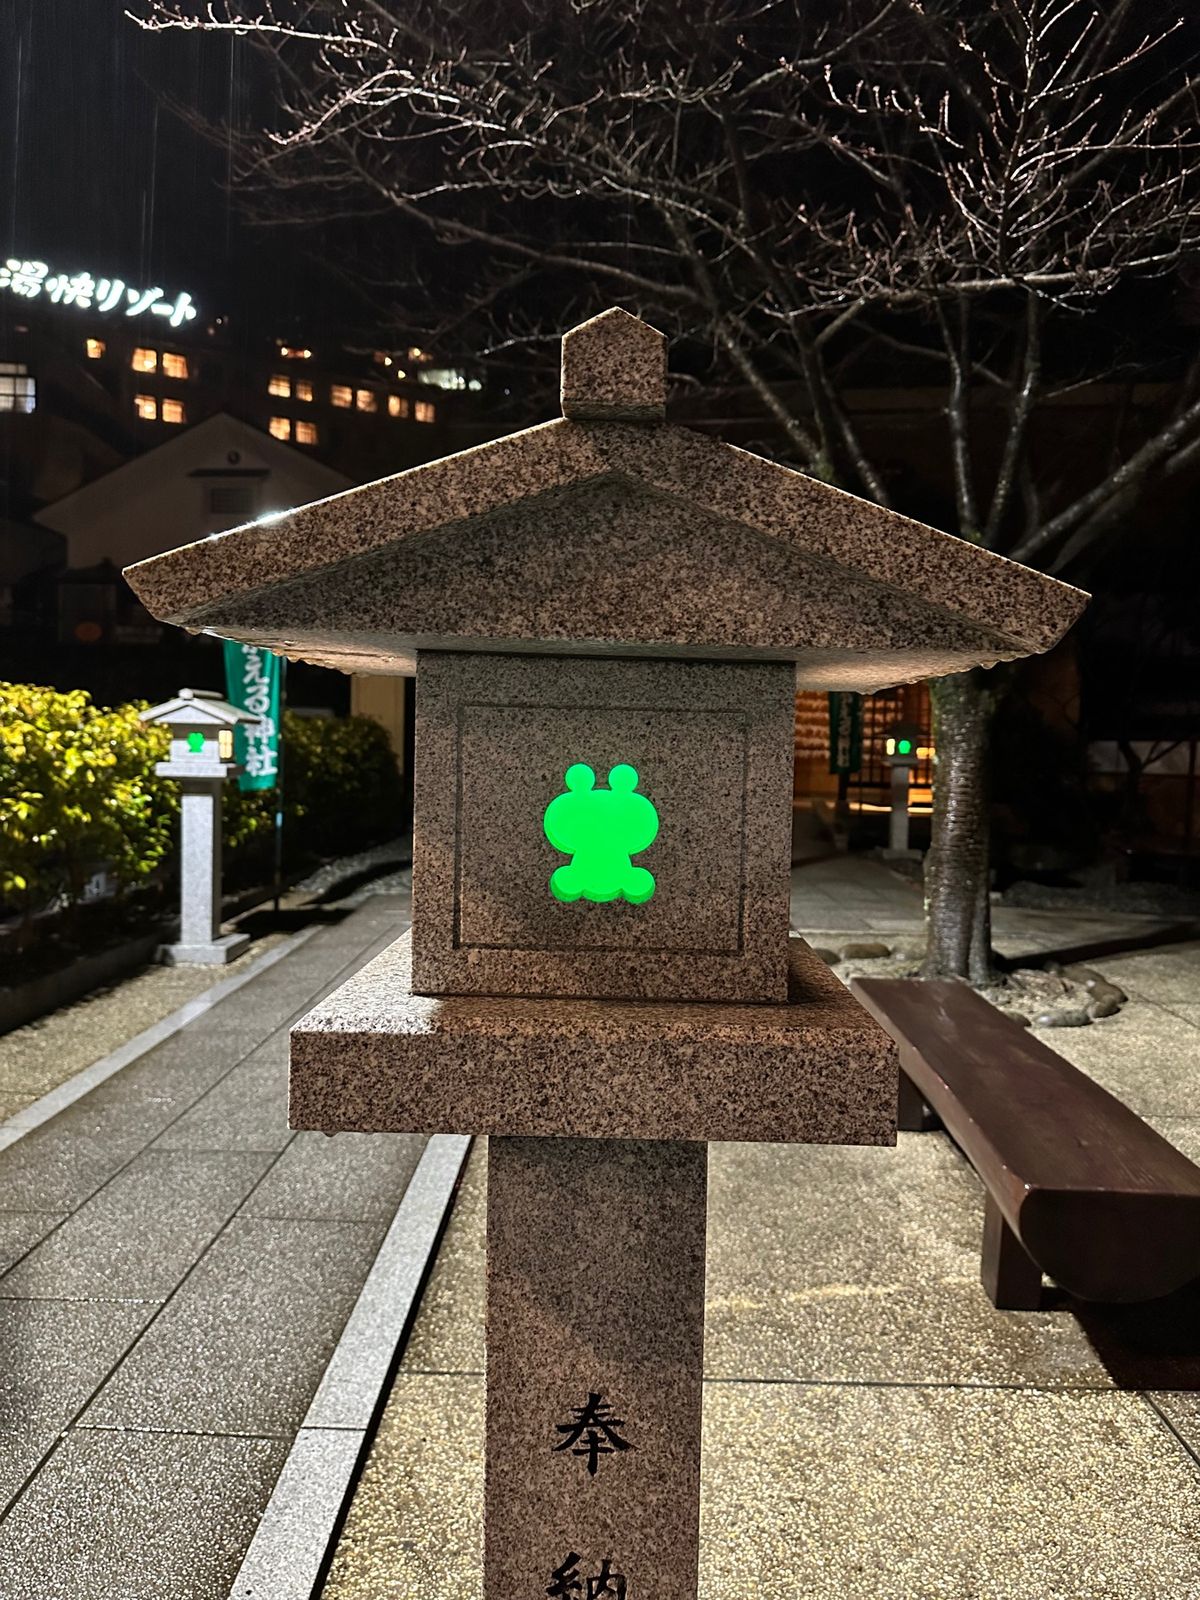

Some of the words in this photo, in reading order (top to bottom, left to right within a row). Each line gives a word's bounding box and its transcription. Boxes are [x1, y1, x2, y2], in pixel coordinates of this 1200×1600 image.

[0, 259, 197, 327] 湯快リゾート
[242, 643, 278, 777] える神社
